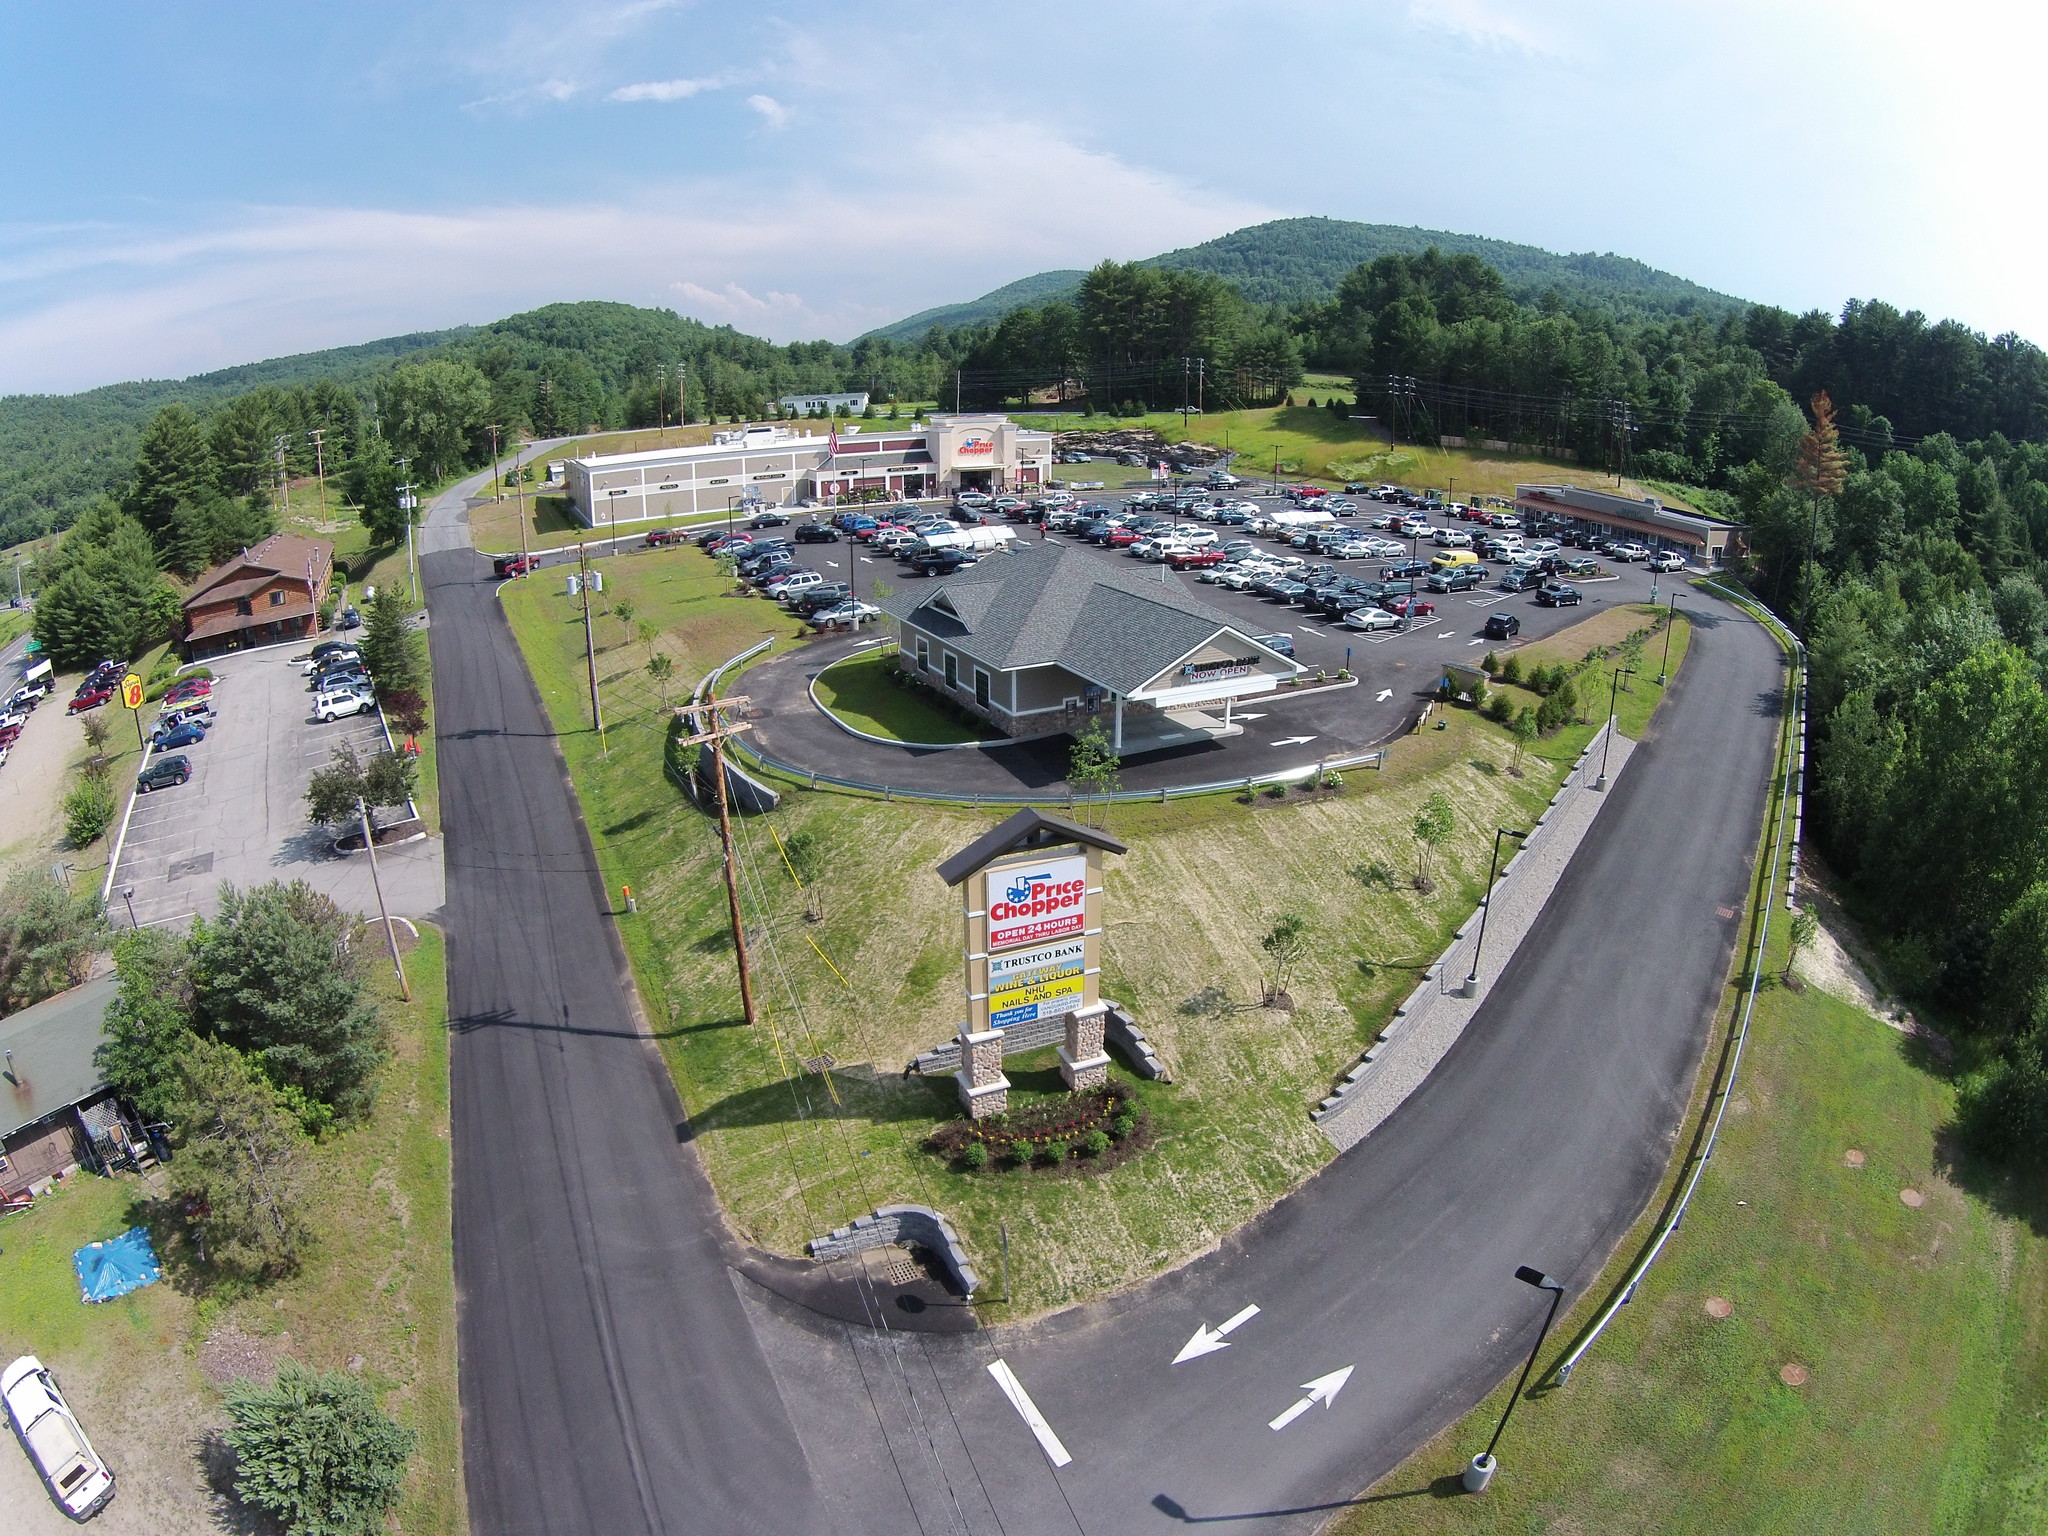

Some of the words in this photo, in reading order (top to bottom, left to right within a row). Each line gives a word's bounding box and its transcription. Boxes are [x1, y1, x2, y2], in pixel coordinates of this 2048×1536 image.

[960, 446, 992, 454] Chopper
[1192, 670, 1216, 680] NOW
[1220, 666, 1246, 675] OPEN
[130, 685, 141, 705] 8
[1032, 880, 1084, 900] Price
[990, 892, 1083, 921] Chopper
[998, 928, 1026, 940] OPEN
[1028, 924, 1042, 933] 24
[1044, 917, 1078, 930] HOURS
[992, 938, 1022, 946] MEMORIAL
[1004, 952, 1052, 968] TRUSTCO
[1055, 945, 1082, 958] BANK
[994, 980, 1024, 992] WINE
[1040, 966, 1080, 982] LIQUOR
[1012, 964, 1062, 980] GATEWAY
[1002, 996, 1030, 1008] NAILS
[1032, 992, 1052, 1001] AND
[1056, 986, 1072, 996] SPA
[1026, 986, 1045, 996] NHU
[1024, 1006, 1033, 1014] for
[992, 1016, 1020, 1026] Shopping
